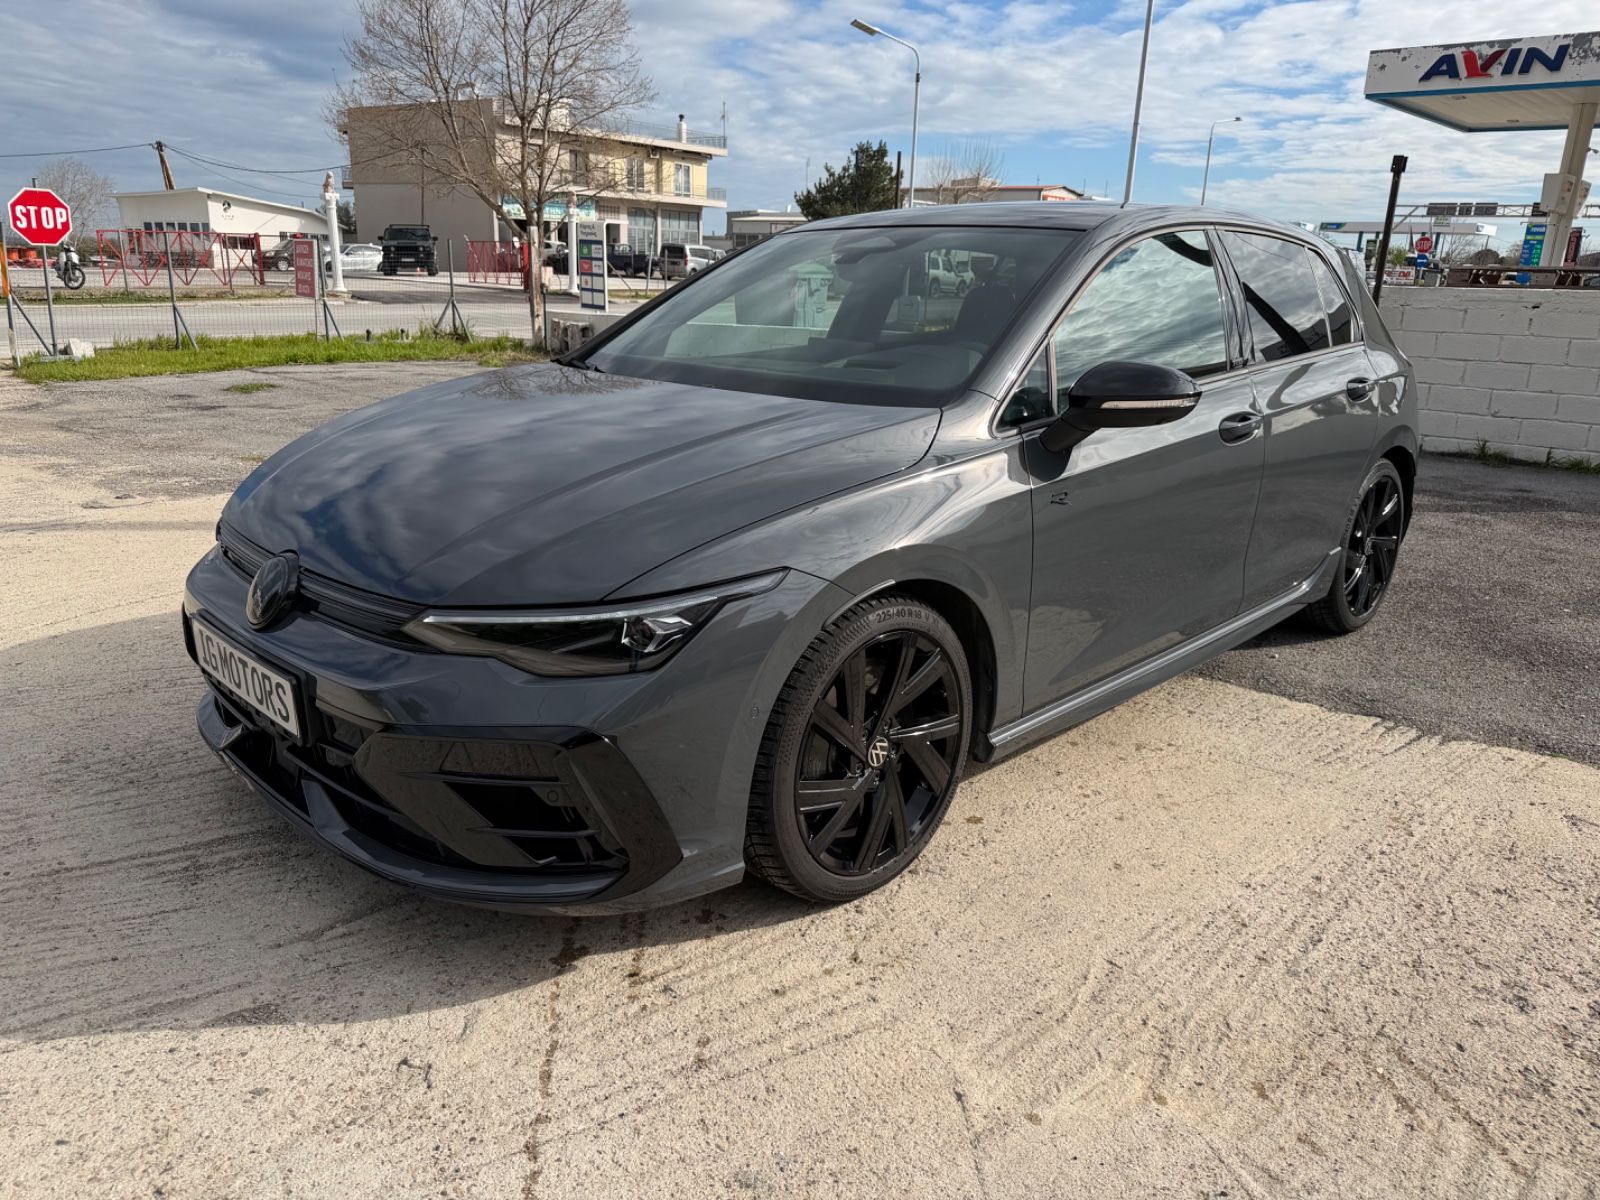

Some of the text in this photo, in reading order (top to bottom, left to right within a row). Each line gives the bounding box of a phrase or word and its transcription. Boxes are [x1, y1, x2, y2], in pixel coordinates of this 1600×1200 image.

[1418, 43, 1571, 83] AVIN
[15, 204, 68, 230] STOP
[1416, 240, 1432, 250] STOP
[876, 609, 906, 623] 225/40
